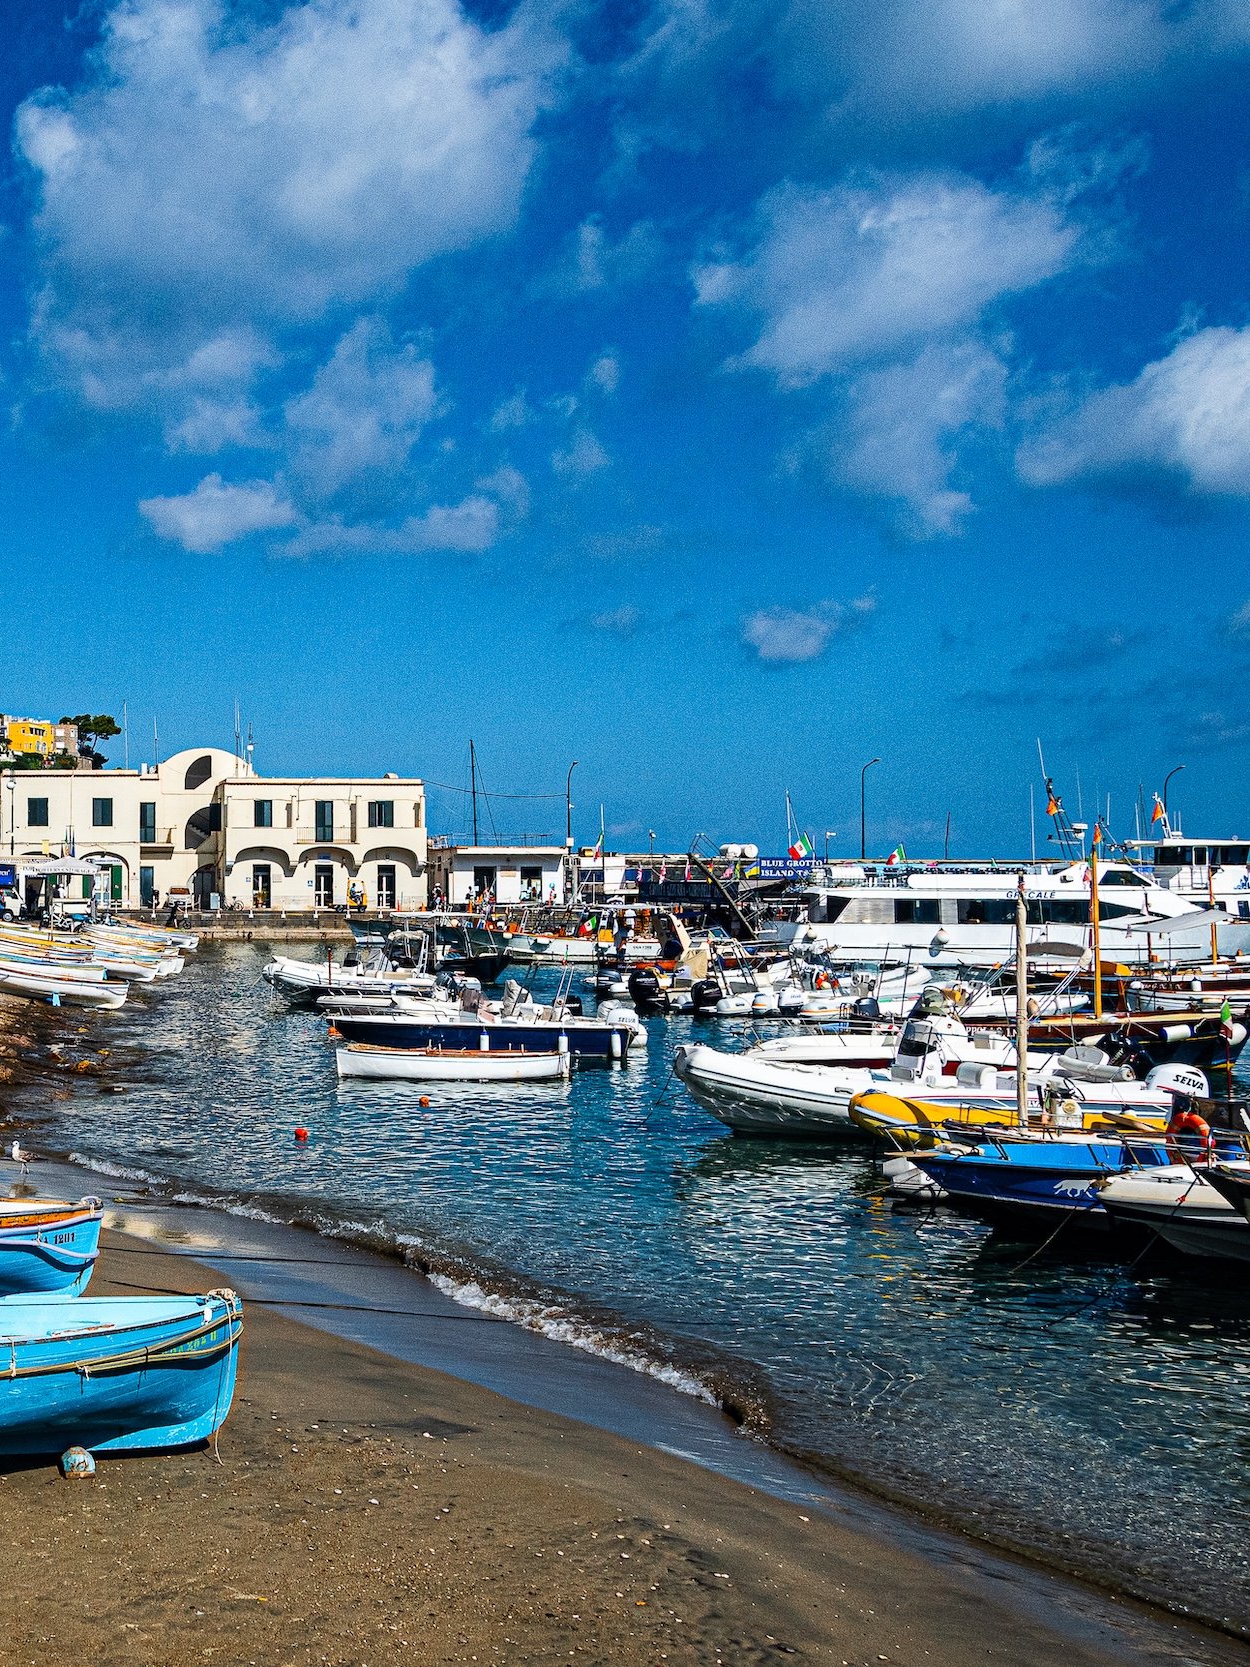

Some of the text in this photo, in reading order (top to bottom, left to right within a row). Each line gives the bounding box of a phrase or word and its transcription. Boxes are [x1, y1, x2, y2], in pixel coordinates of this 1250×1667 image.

[761, 859, 823, 867] BLUE GROTTO
[761, 869, 794, 877] ISLAND
[1006, 889, 1056, 899] GRCALE
[1172, 1074, 1204, 1091] SELVA
